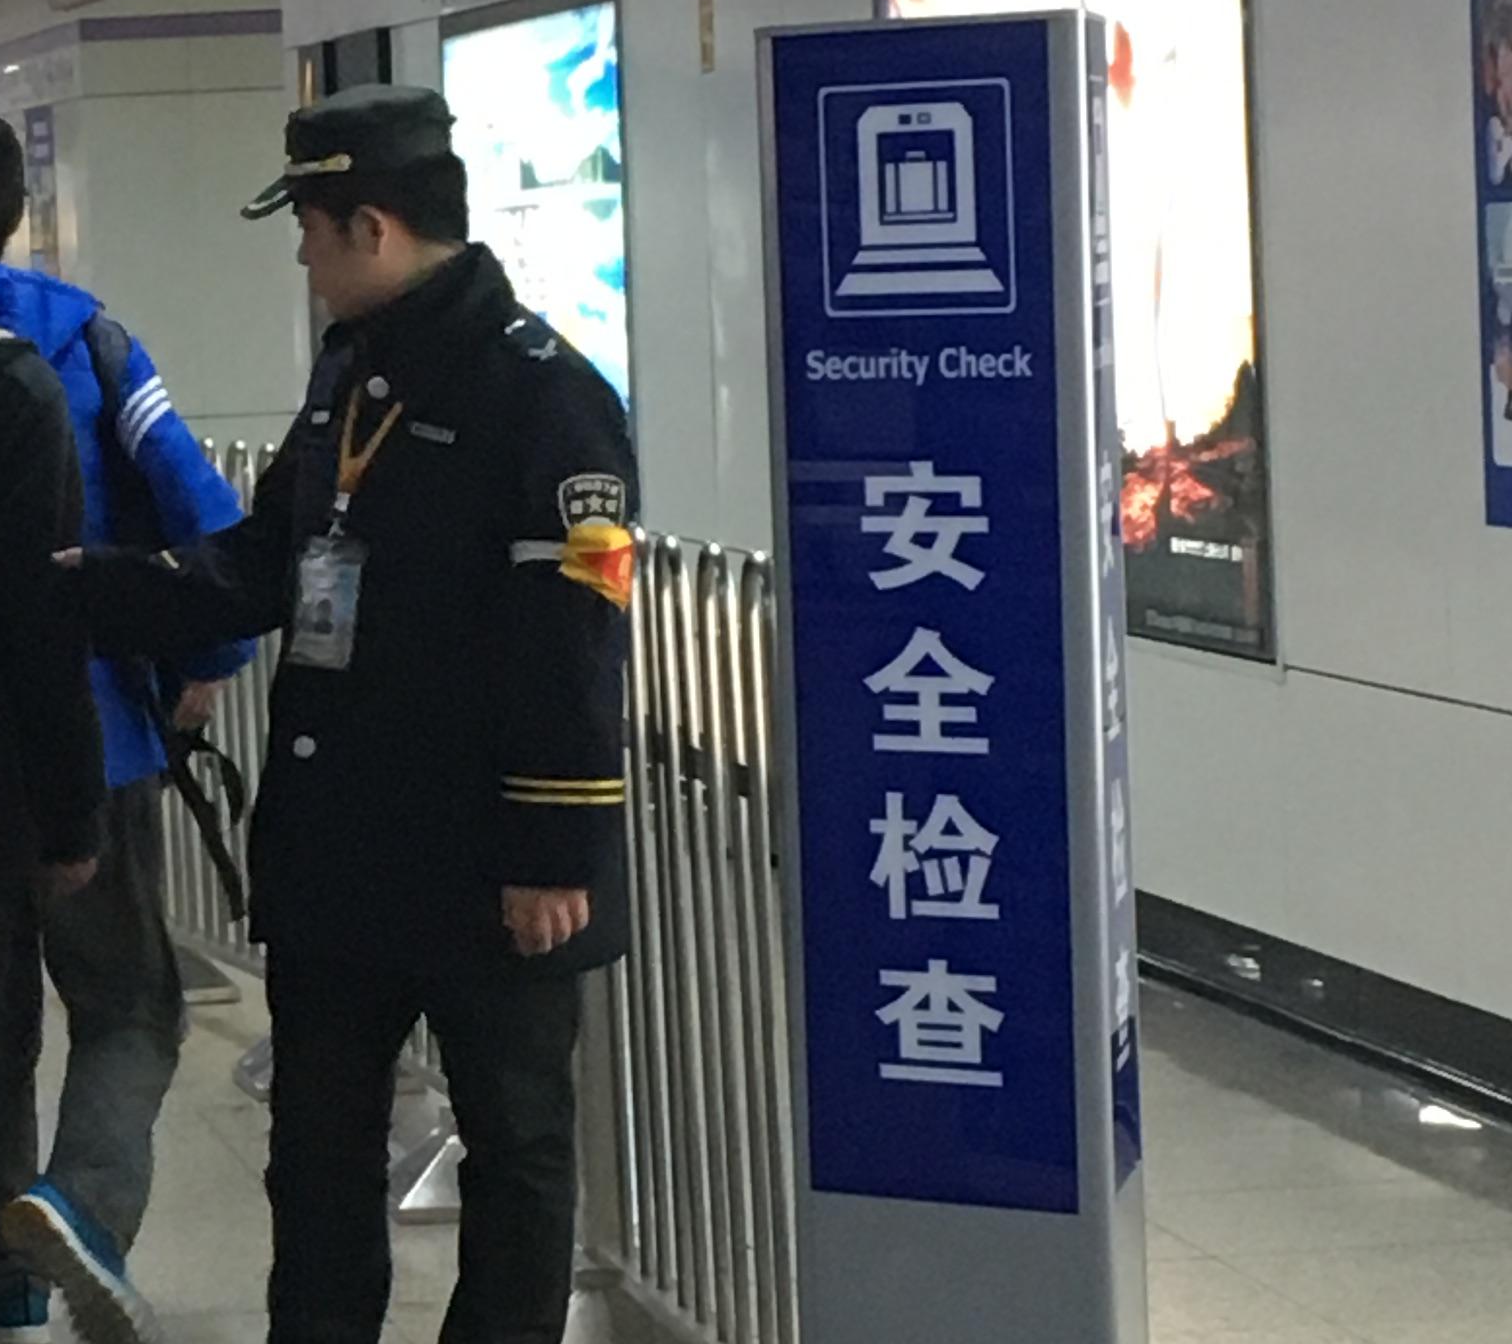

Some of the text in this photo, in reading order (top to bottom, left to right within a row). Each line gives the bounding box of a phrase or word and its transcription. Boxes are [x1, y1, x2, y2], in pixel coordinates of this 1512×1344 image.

[805, 345, 1032, 386] Security Check
[861, 460, 1005, 1087] 安全检查
